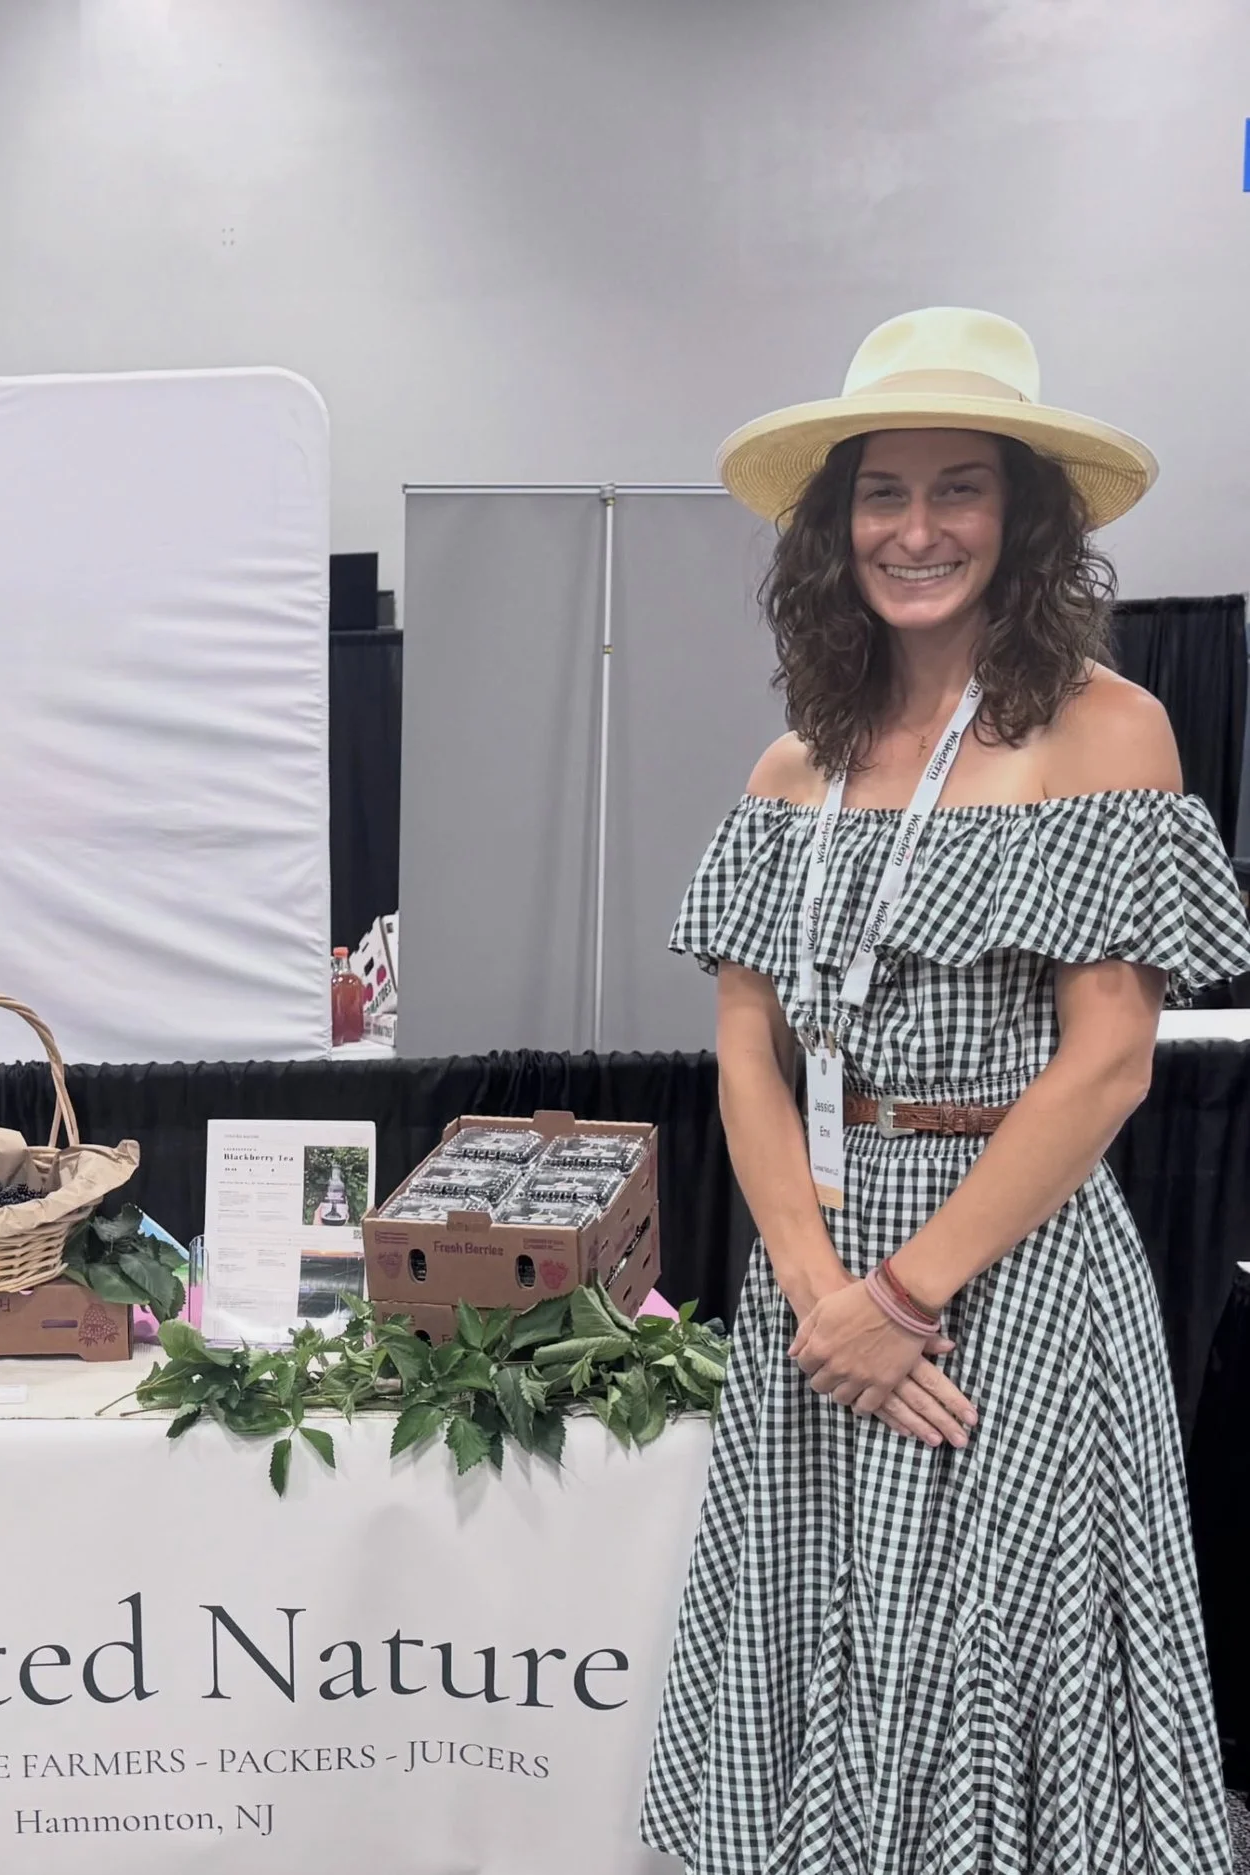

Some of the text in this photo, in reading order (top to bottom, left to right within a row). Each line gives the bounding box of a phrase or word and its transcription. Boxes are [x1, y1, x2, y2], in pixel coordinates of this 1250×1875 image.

[929, 730, 960, 781] Wakefern
[817, 813, 833, 865] Wakefern
[894, 813, 922, 867] Wakefern
[863, 900, 890, 954] Wakefern
[223, 1153, 274, 1162] Blackberry
[433, 1240, 504, 1256] Fresh Berries
[199, 1604, 630, 1711] Nature
[22, 1748, 186, 1779] FARMERS
[218, 1744, 377, 1774] PACKERS
[403, 1740, 551, 1780] JUICERS
[14, 1803, 276, 1838] Hammonton, NJ
